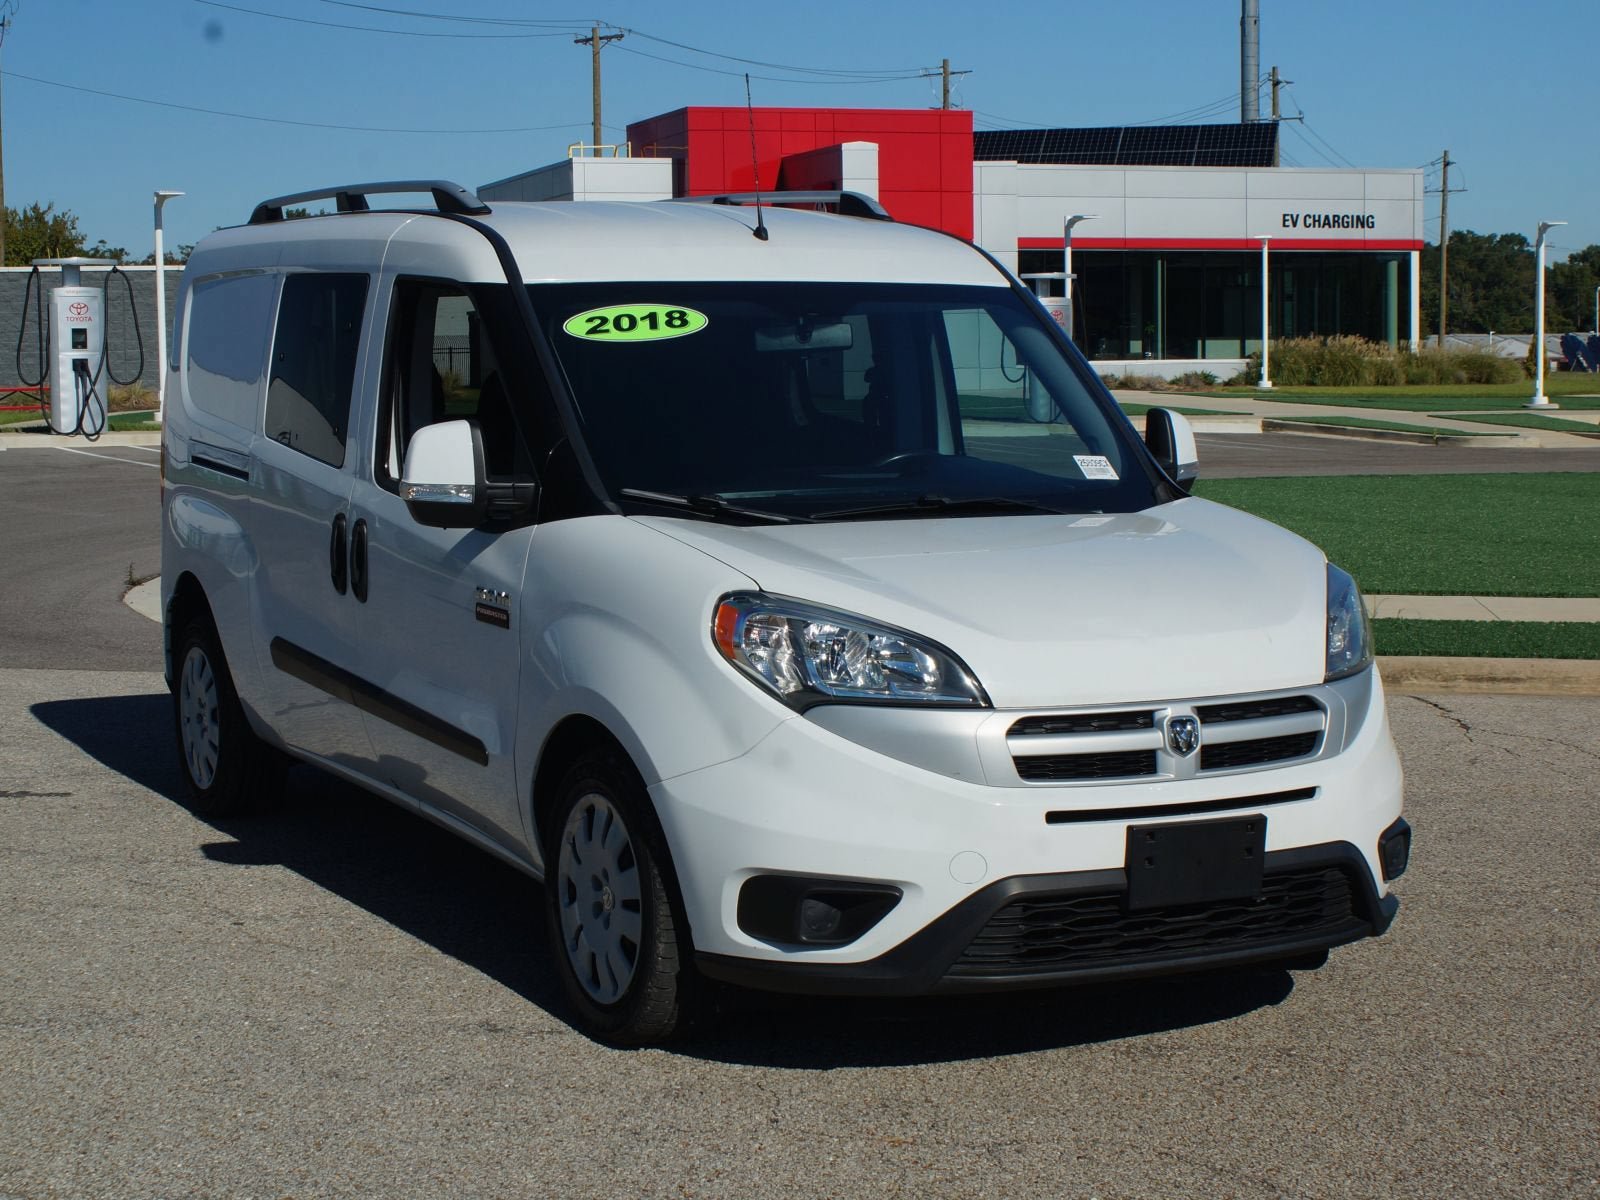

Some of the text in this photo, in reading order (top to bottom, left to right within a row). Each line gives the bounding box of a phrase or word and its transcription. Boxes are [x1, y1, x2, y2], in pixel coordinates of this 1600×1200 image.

[1282, 213, 1376, 229] EV CHARGING
[585, 309, 689, 336] 2018
